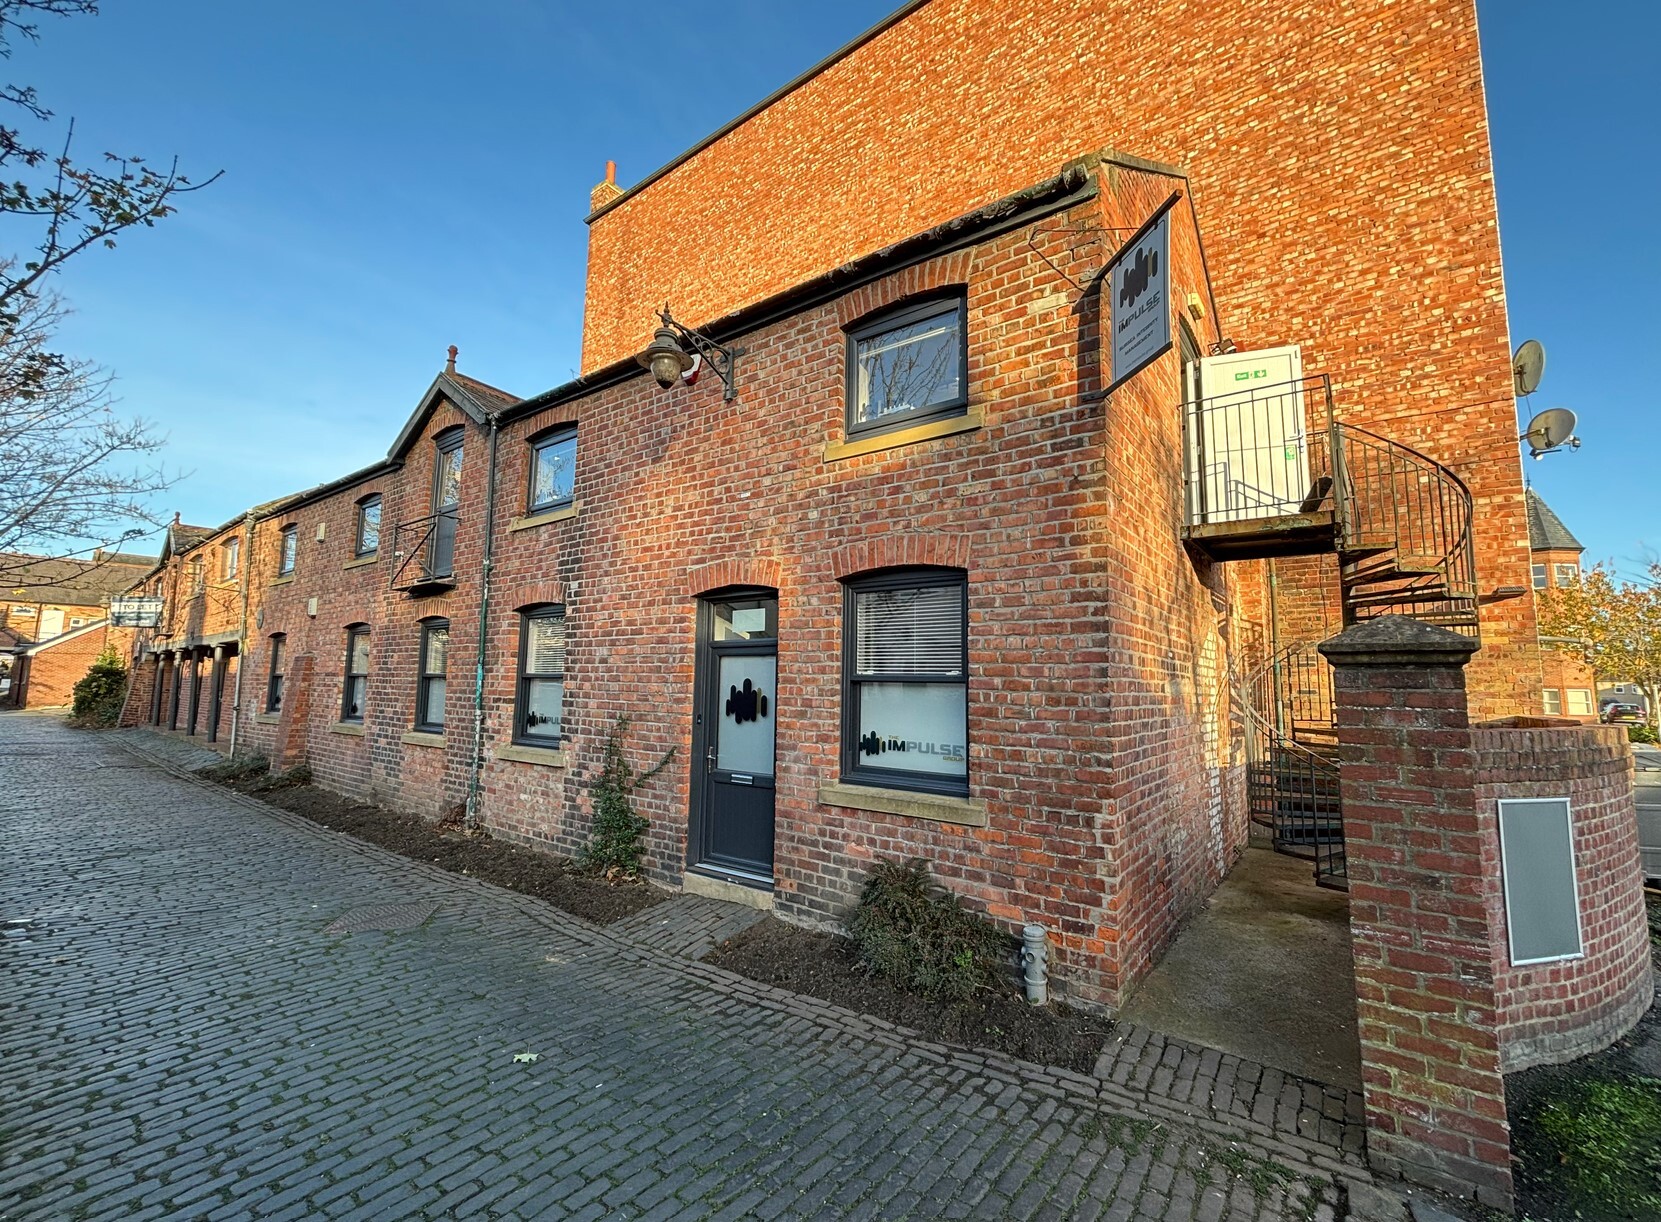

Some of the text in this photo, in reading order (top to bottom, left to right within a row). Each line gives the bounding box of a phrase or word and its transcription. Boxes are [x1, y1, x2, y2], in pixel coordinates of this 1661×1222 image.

[1118, 290, 1160, 333] IMPULSE
[1124, 329, 1154, 356] MANAGEMENT
[888, 739, 965, 757] IMPULSE
